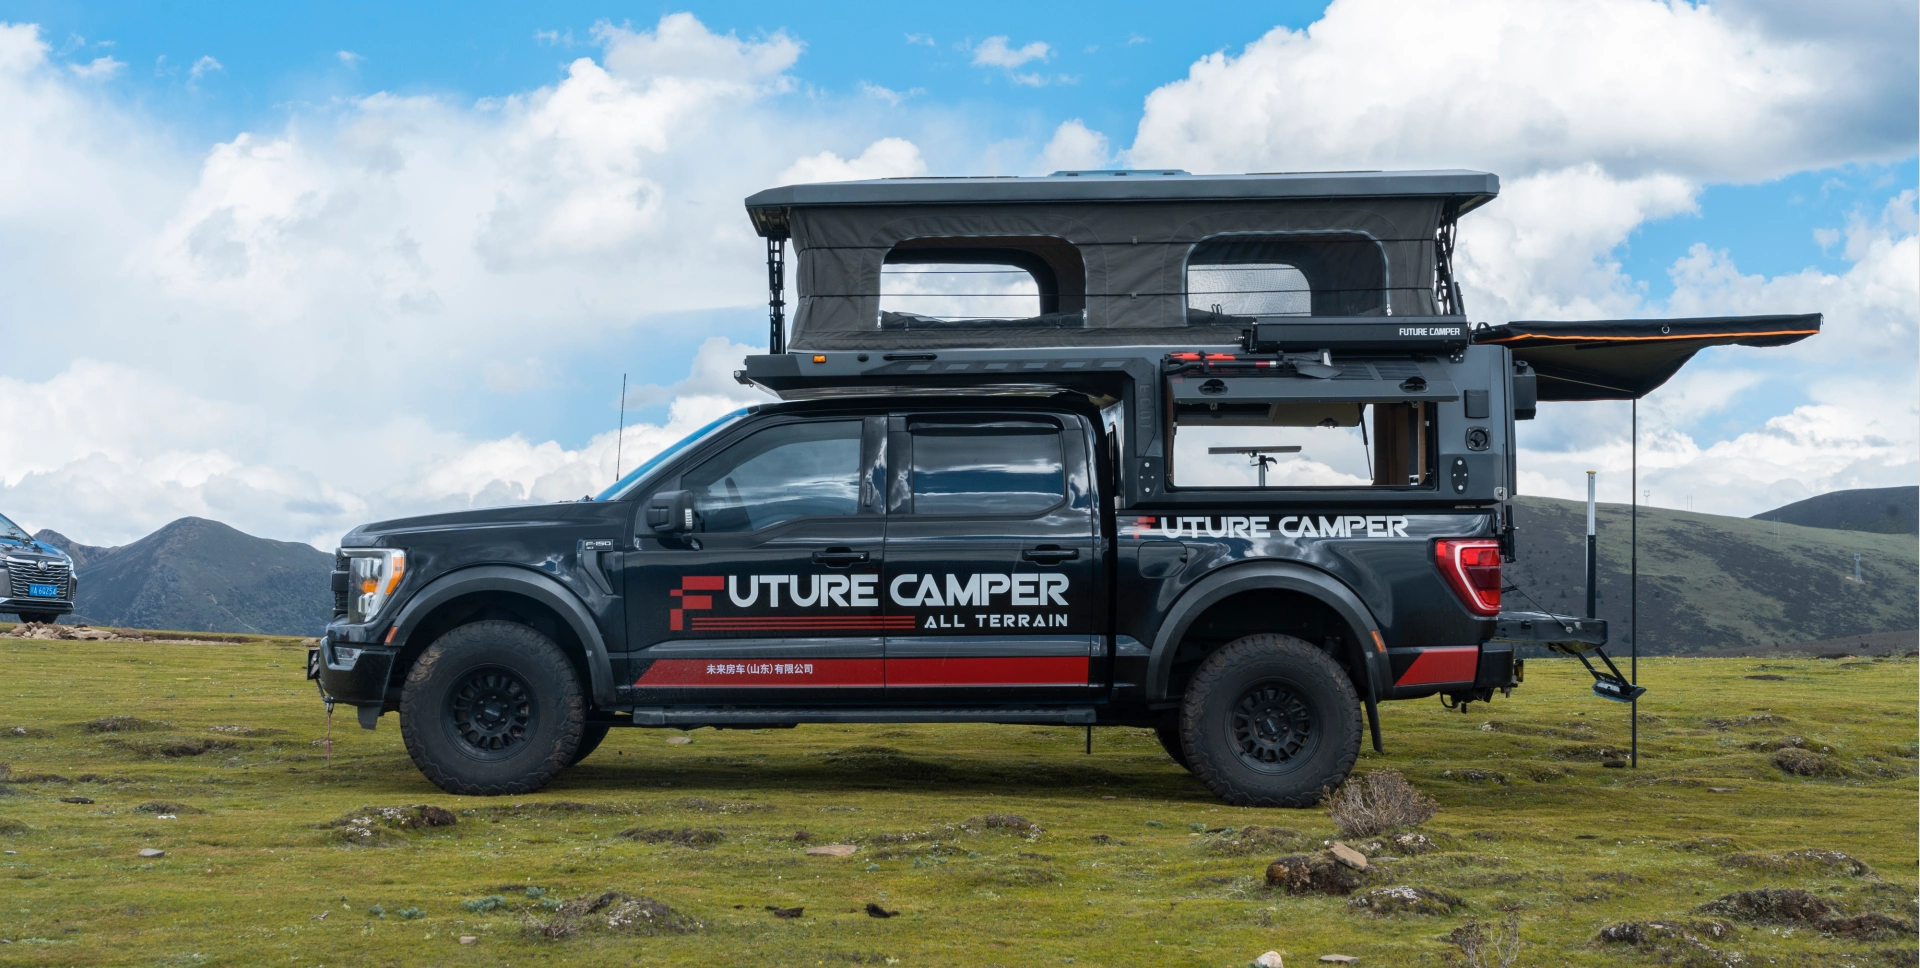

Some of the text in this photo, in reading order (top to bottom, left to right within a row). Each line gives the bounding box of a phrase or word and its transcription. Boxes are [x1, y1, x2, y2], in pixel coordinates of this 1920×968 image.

[1399, 327, 1461, 336] FUTURE CAMPER
[1132, 516, 1410, 539] FUTURE CAMPER
[670, 573, 1069, 631] FUTURE CAMPER
[924, 614, 1068, 628] ALL TERRAIN
